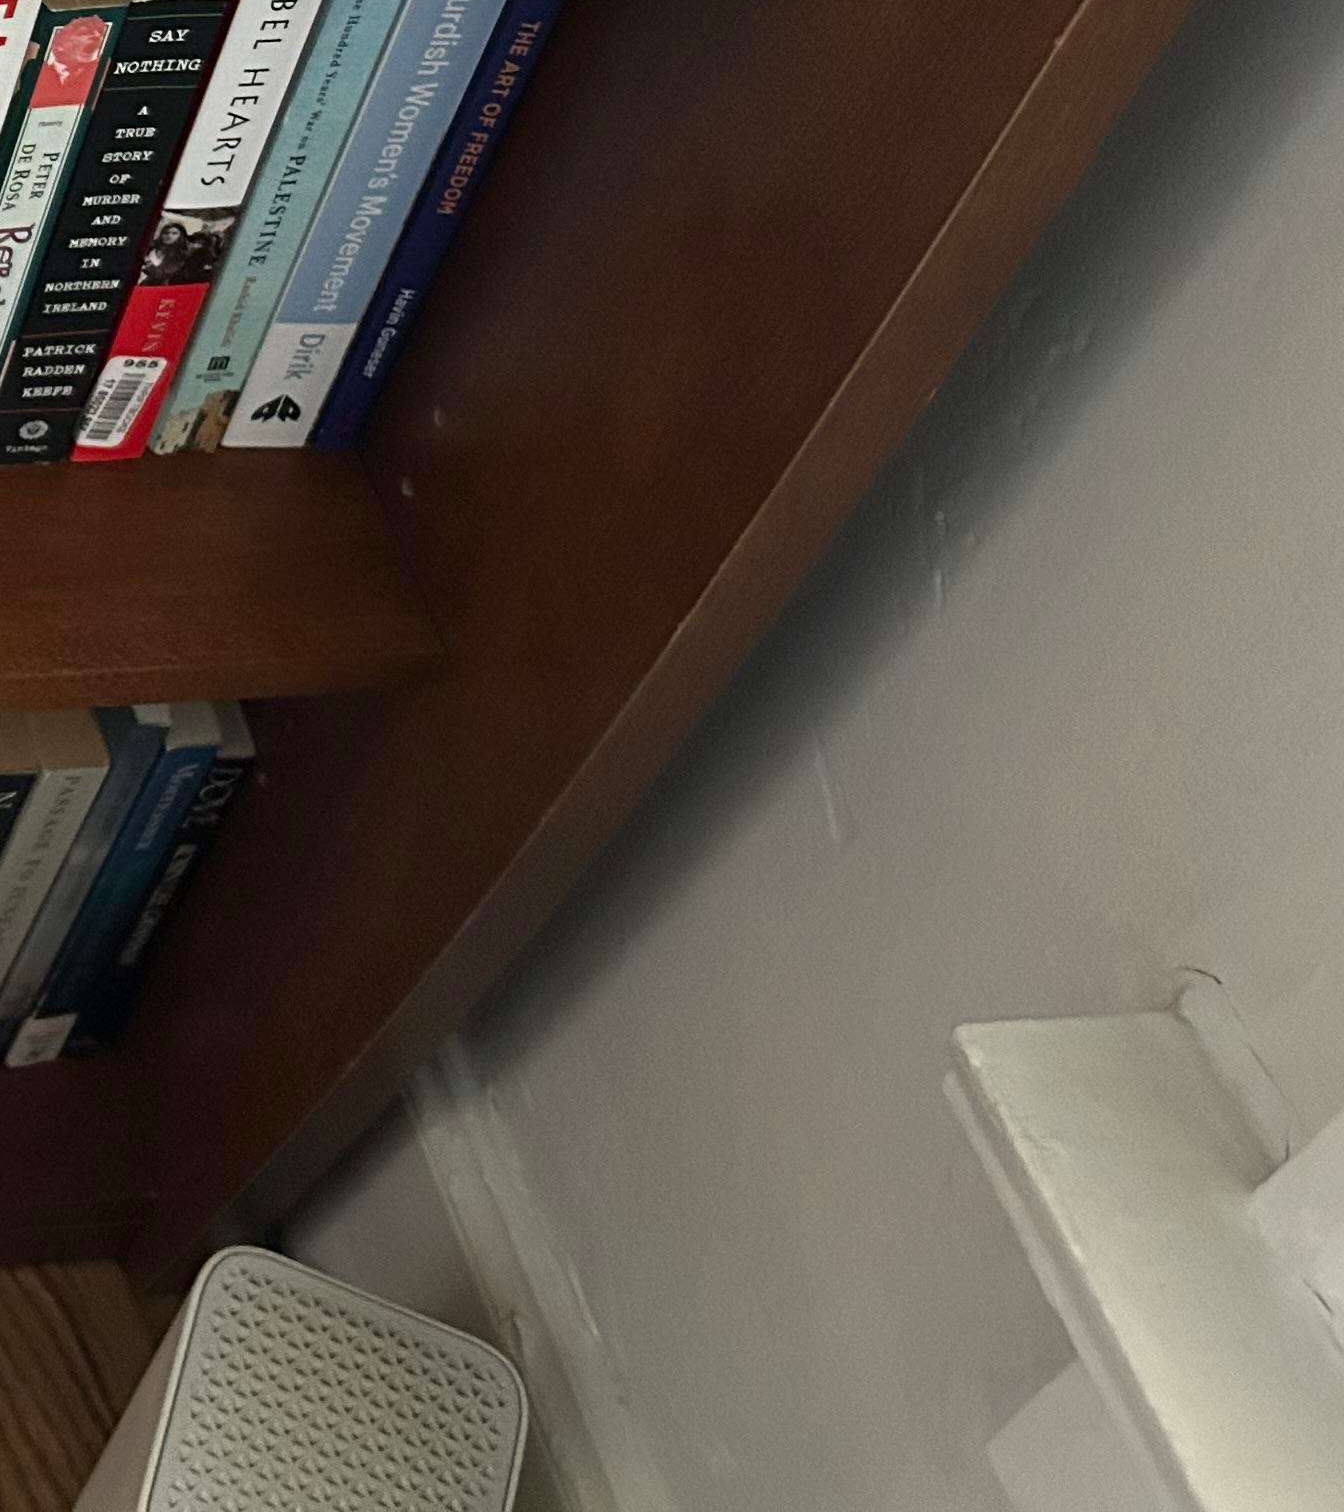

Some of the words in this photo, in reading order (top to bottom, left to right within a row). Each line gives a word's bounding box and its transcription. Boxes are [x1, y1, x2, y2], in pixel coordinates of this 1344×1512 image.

[148, 29, 189, 43] SAY
[113, 57, 202, 75] NOTHING
[137, 105, 150, 116] A
[115, 126, 155, 139] TRUE
[102, 150, 153, 163] STORY
[109, 174, 131, 185] OF
[82, 193, 141, 206] MURDER
[91, 214, 122, 226] AND
[68, 236, 127, 249] MEMORY
[80, 257, 101, 269] IN
[44, 280, 120, 293] NORTHERN
[43, 301, 108, 314] IRELAND
[22, 343, 97, 358] PATRICK
[22, 364, 85, 377] RADDEN
[21, 384, 73, 398] KEEFE
